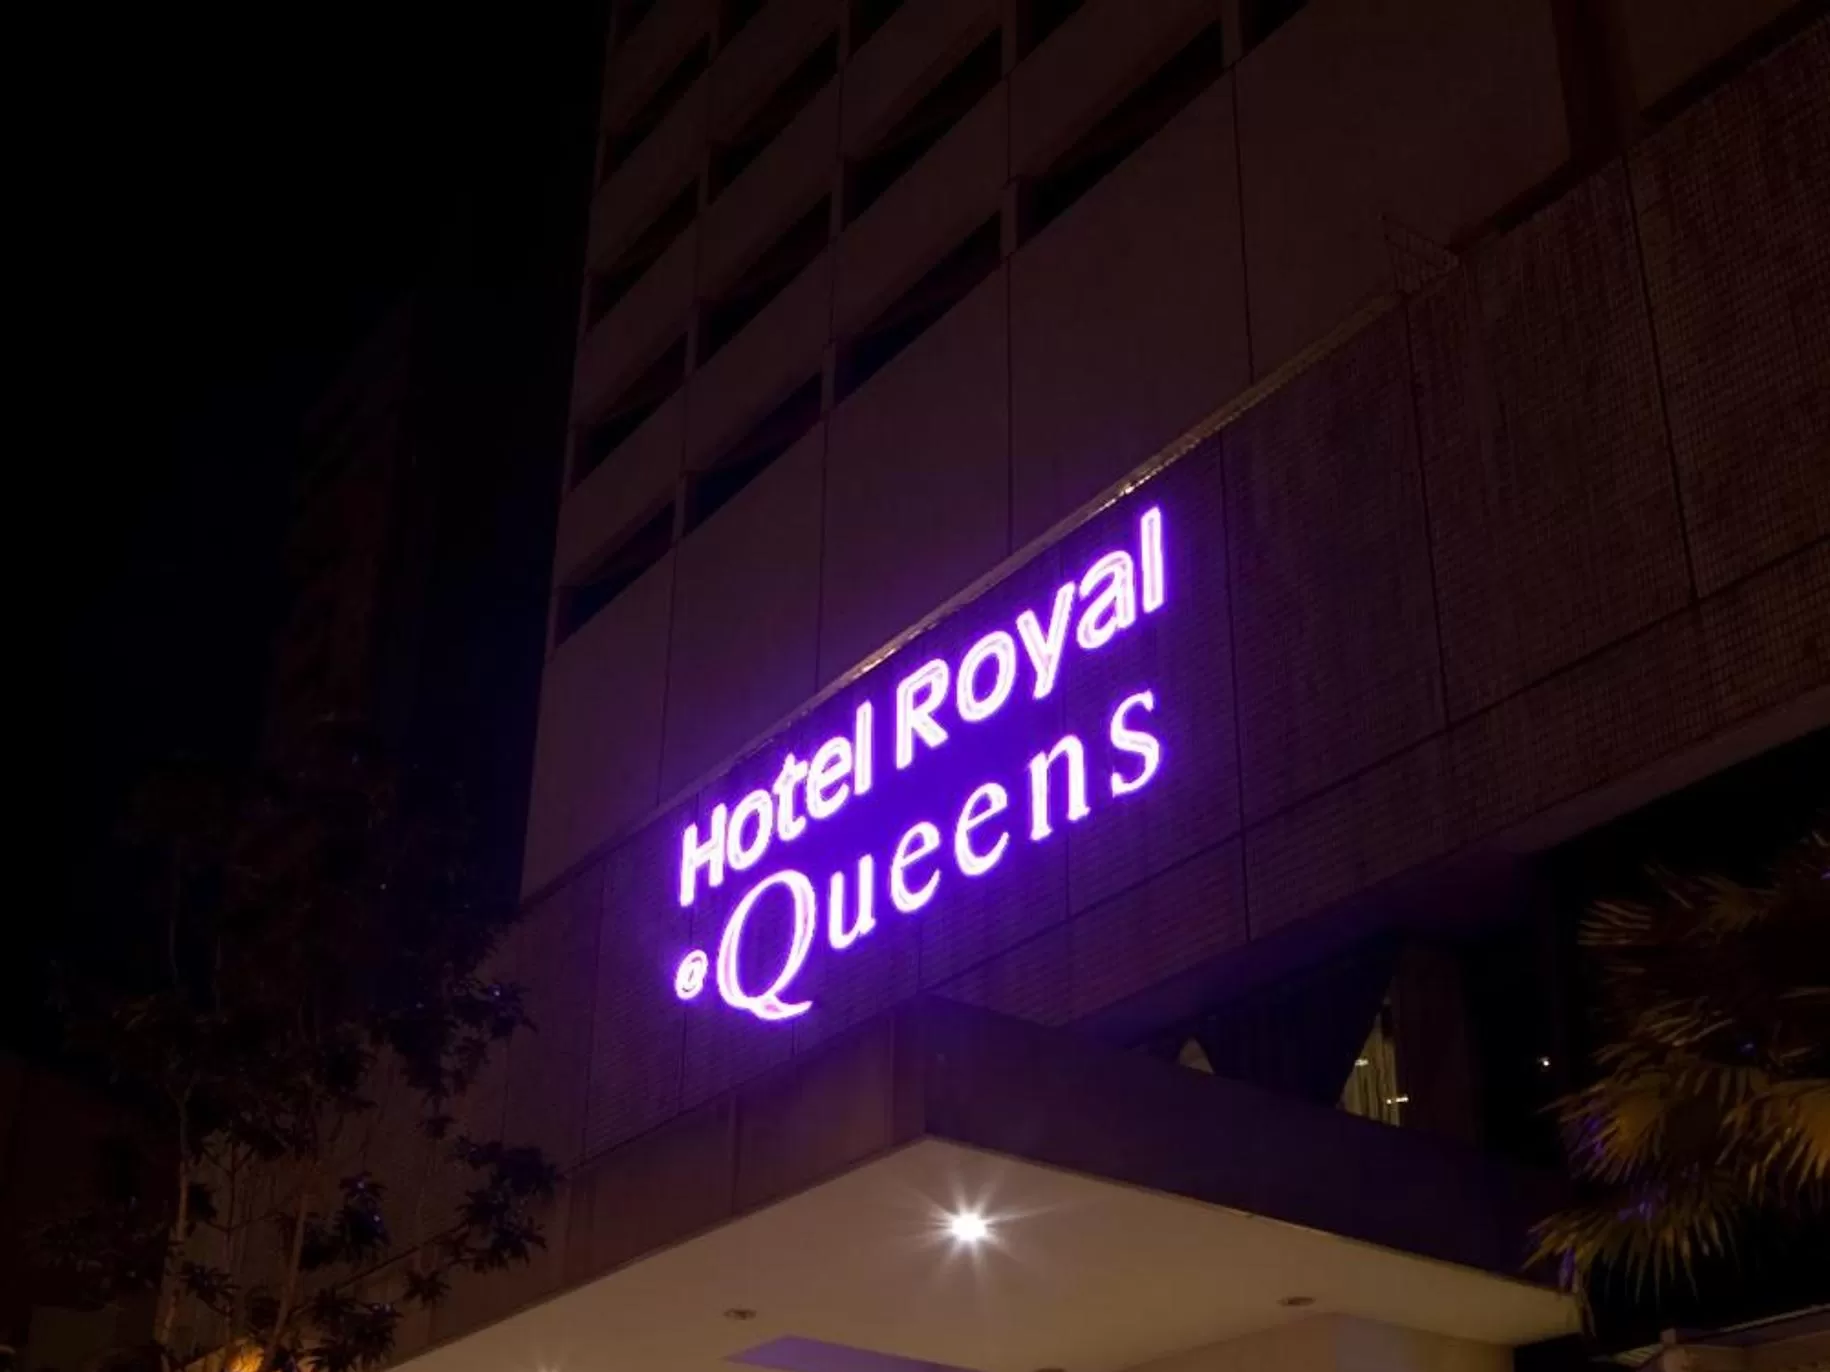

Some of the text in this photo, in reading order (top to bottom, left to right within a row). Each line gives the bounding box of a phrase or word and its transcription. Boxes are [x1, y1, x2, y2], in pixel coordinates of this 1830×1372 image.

[679, 506, 1165, 907] Hotel Royal
[716, 689, 1160, 1020] Queens
